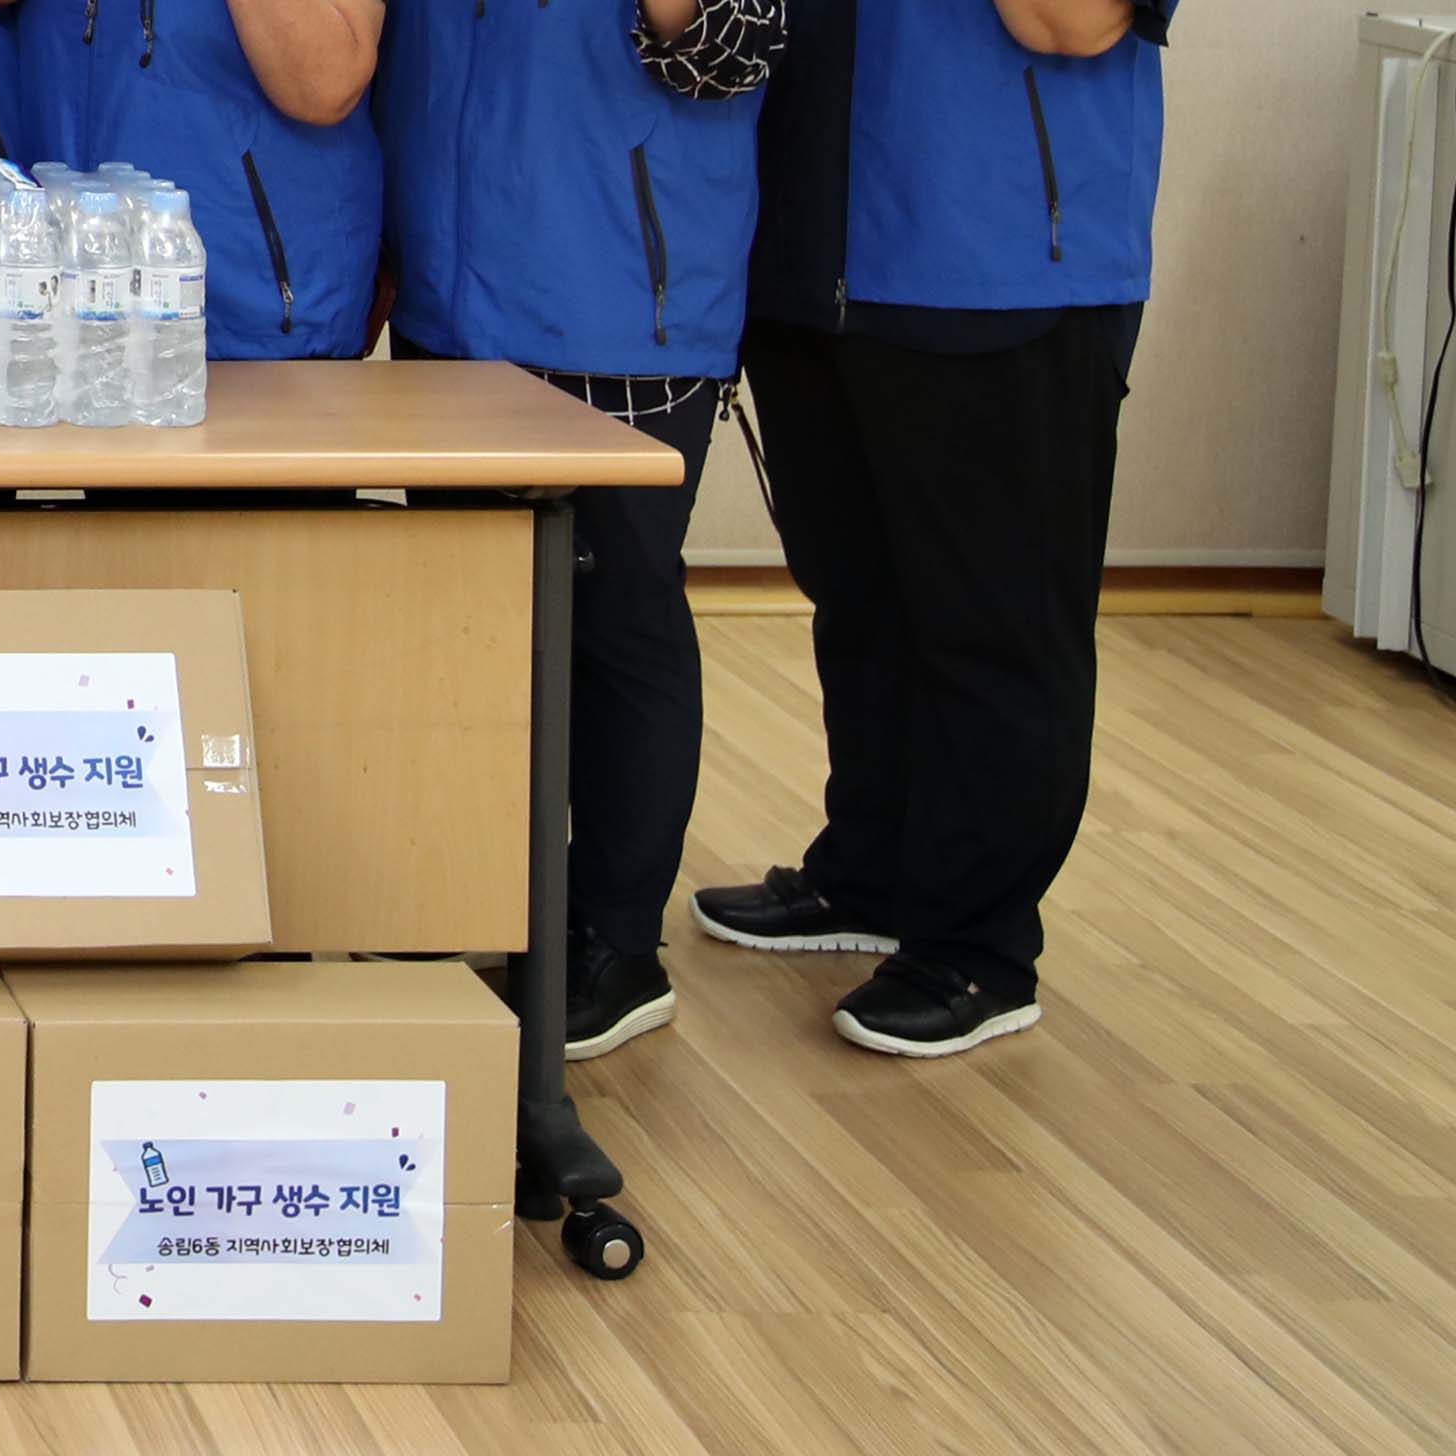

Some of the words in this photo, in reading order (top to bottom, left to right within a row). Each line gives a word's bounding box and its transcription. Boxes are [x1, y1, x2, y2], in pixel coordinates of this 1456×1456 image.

[18, 756, 74, 790] 생수
[84, 755, 143, 789] 지원
[139, 1186, 195, 1217] 노인
[206, 1185, 262, 1217] 가구
[272, 1184, 330, 1218] 생수
[340, 1184, 400, 1217] 지원
[158, 1237, 220, 1257] 송림6동
[227, 1237, 389, 1257] 지역사회보장협의체
